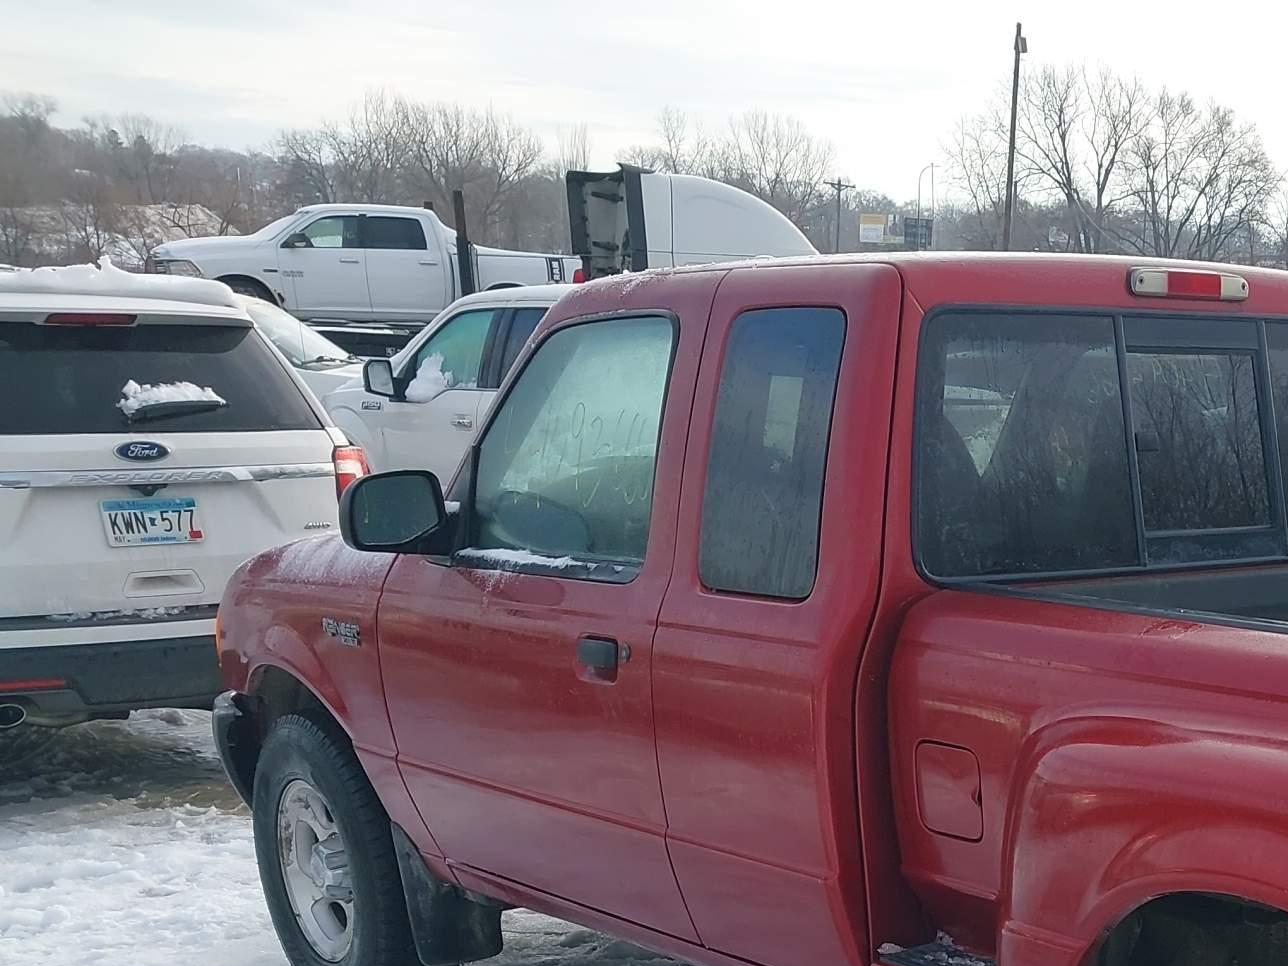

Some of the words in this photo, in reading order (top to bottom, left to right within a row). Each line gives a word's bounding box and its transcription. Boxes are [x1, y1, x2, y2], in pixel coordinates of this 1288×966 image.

[127, 443, 159, 457] Ford
[69, 471, 223, 483] EXPLORER
[108, 510, 149, 536] KWN
[160, 508, 195, 532] 577
